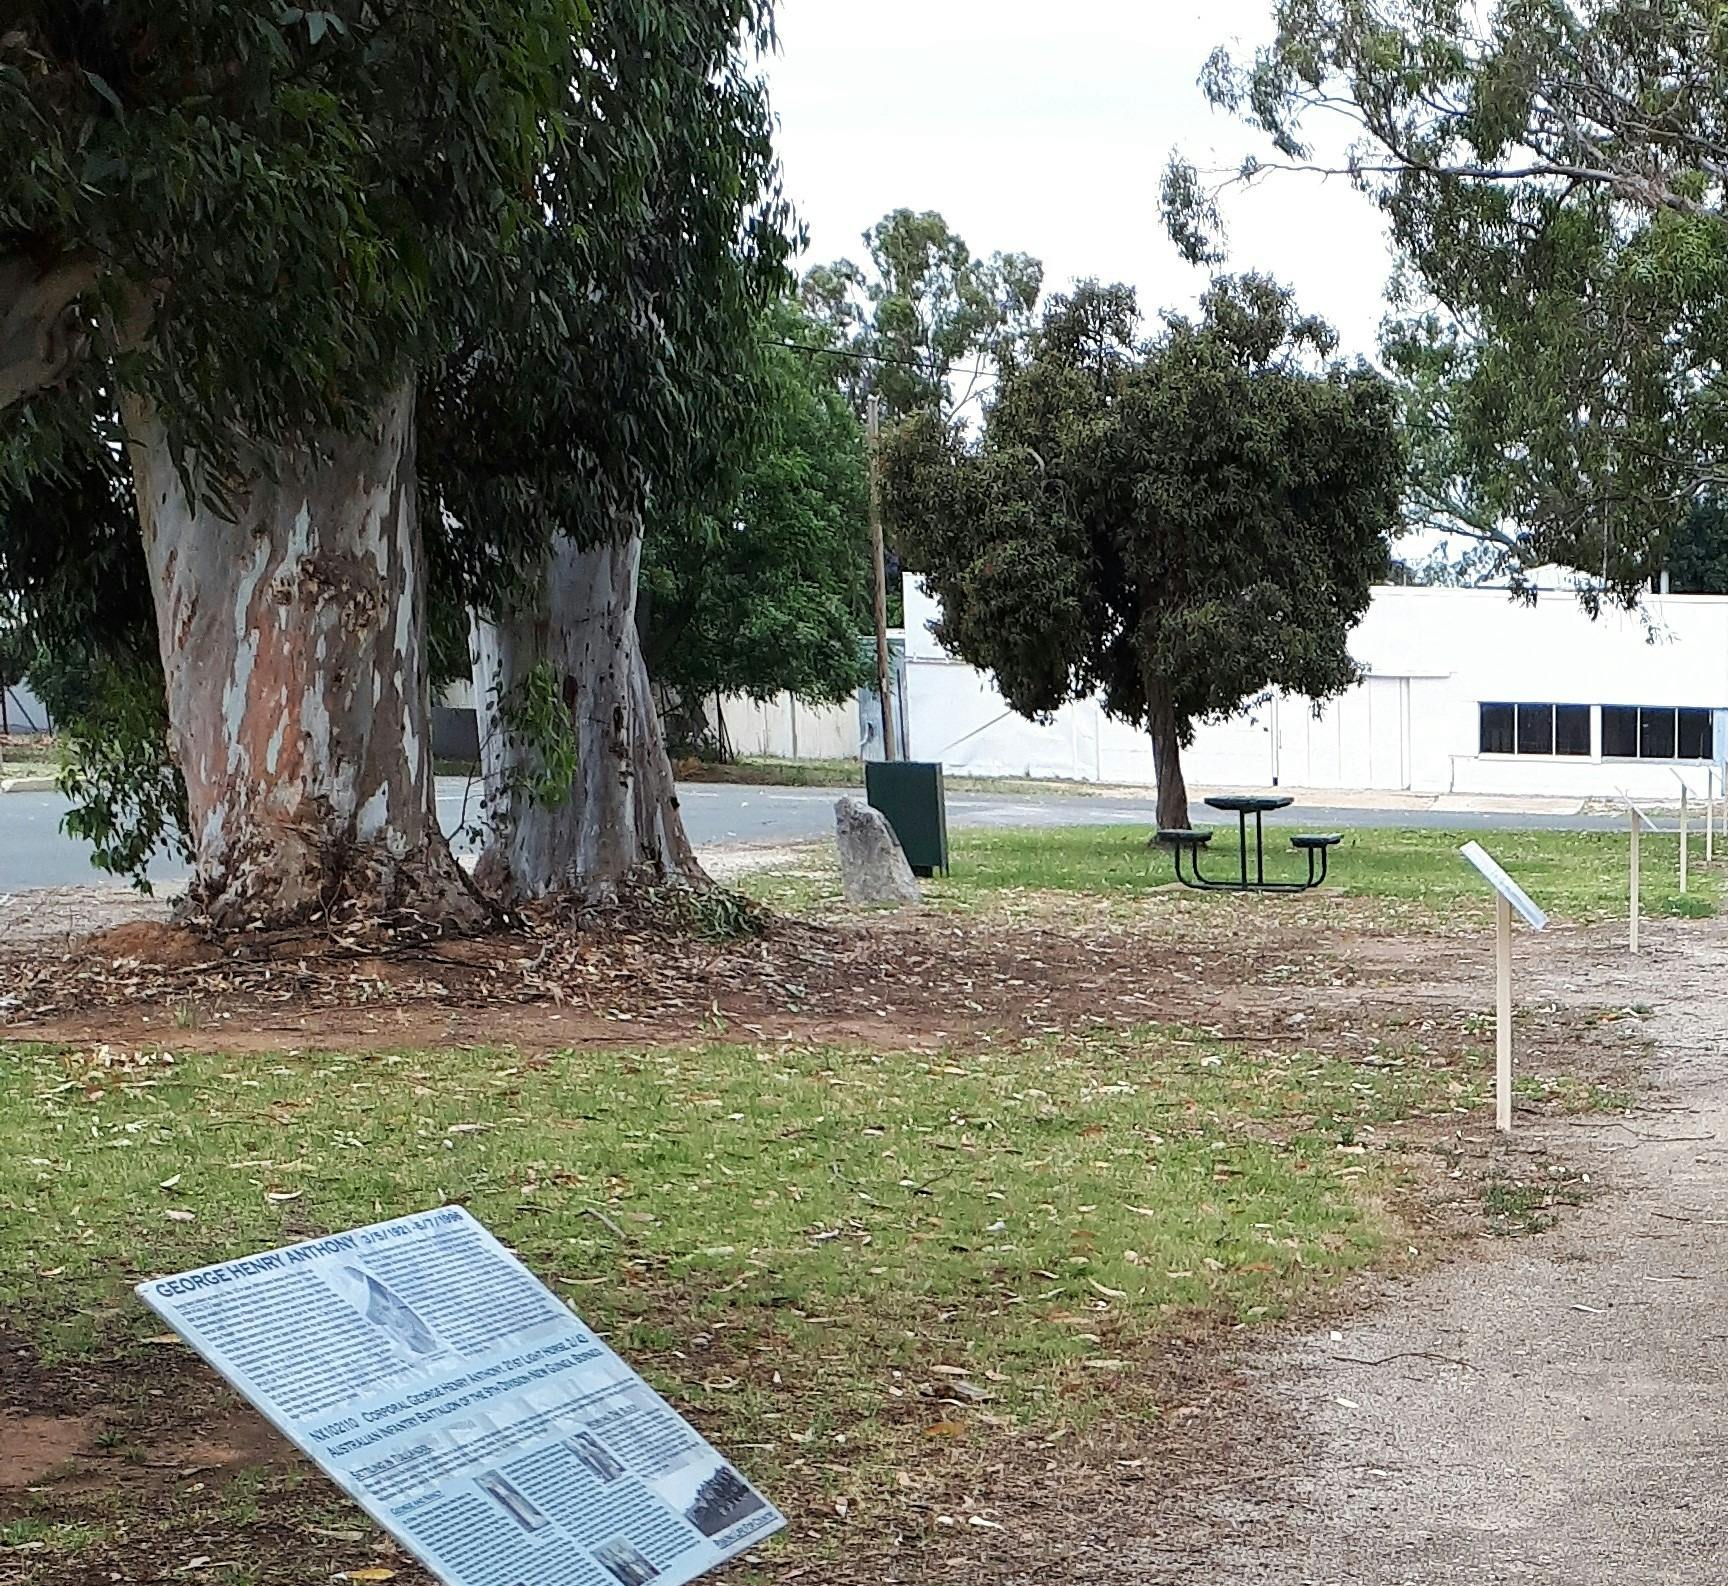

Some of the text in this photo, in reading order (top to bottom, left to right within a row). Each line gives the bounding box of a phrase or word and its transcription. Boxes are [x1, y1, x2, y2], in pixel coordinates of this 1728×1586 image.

[152, 1268, 232, 1298] GEORGE
[226, 1254, 288, 1278] HENRY
[281, 1235, 361, 1264] ANTHONY
[324, 1429, 384, 1458] AUSTRALIAN
[376, 1415, 421, 1437] INFANTRY
[414, 1398, 463, 1423] BATTALION
[358, 1397, 411, 1422] CORPORAL
[404, 1385, 444, 1405] GEORGE
